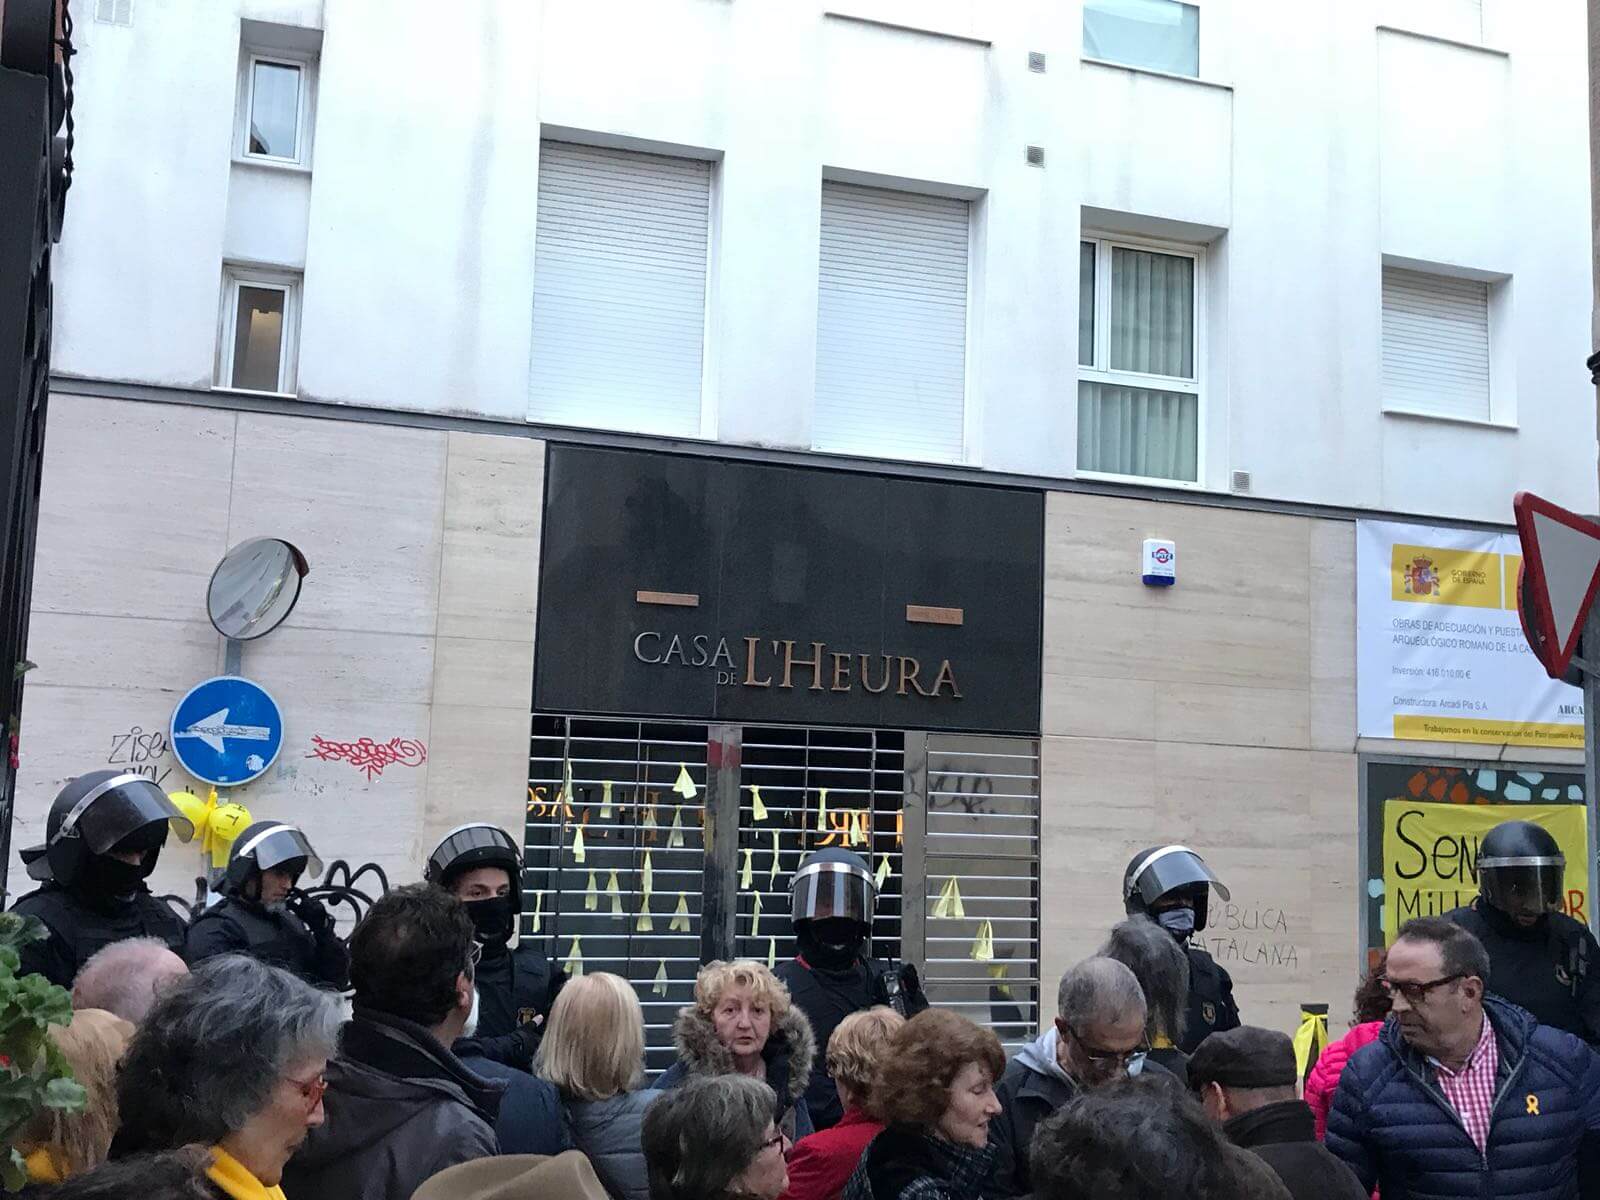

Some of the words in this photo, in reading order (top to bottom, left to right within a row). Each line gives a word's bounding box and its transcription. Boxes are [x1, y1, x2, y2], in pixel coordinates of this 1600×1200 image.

[1450, 568, 1487, 579] GOBIERNO
[1452, 576, 1461, 584] DE
[1392, 618, 1421, 630] OBRAS
[1422, 619, 1433, 631] DE
[1434, 621, 1487, 635] ADECUACIÓN
[1488, 625, 1494, 635] Y
[1392, 634, 1458, 649] ARQUEOLÓGICO
[1459, 639, 1494, 652] ROMANO
[1496, 641, 1506, 653] DE
[1507, 643, 1518, 654] LA
[1519, 643, 1533, 656] CA
[634, 631, 737, 668] CASA
[716, 671, 737, 686] DE
[742, 636, 963, 698] L'HEURA
[1465, 669, 1472, 680] €
[1557, 704, 1584, 715] ARCA
[1423, 723, 1461, 735] Trabajamos
[1463, 727, 1471, 735] en
[1472, 726, 1479, 736] la
